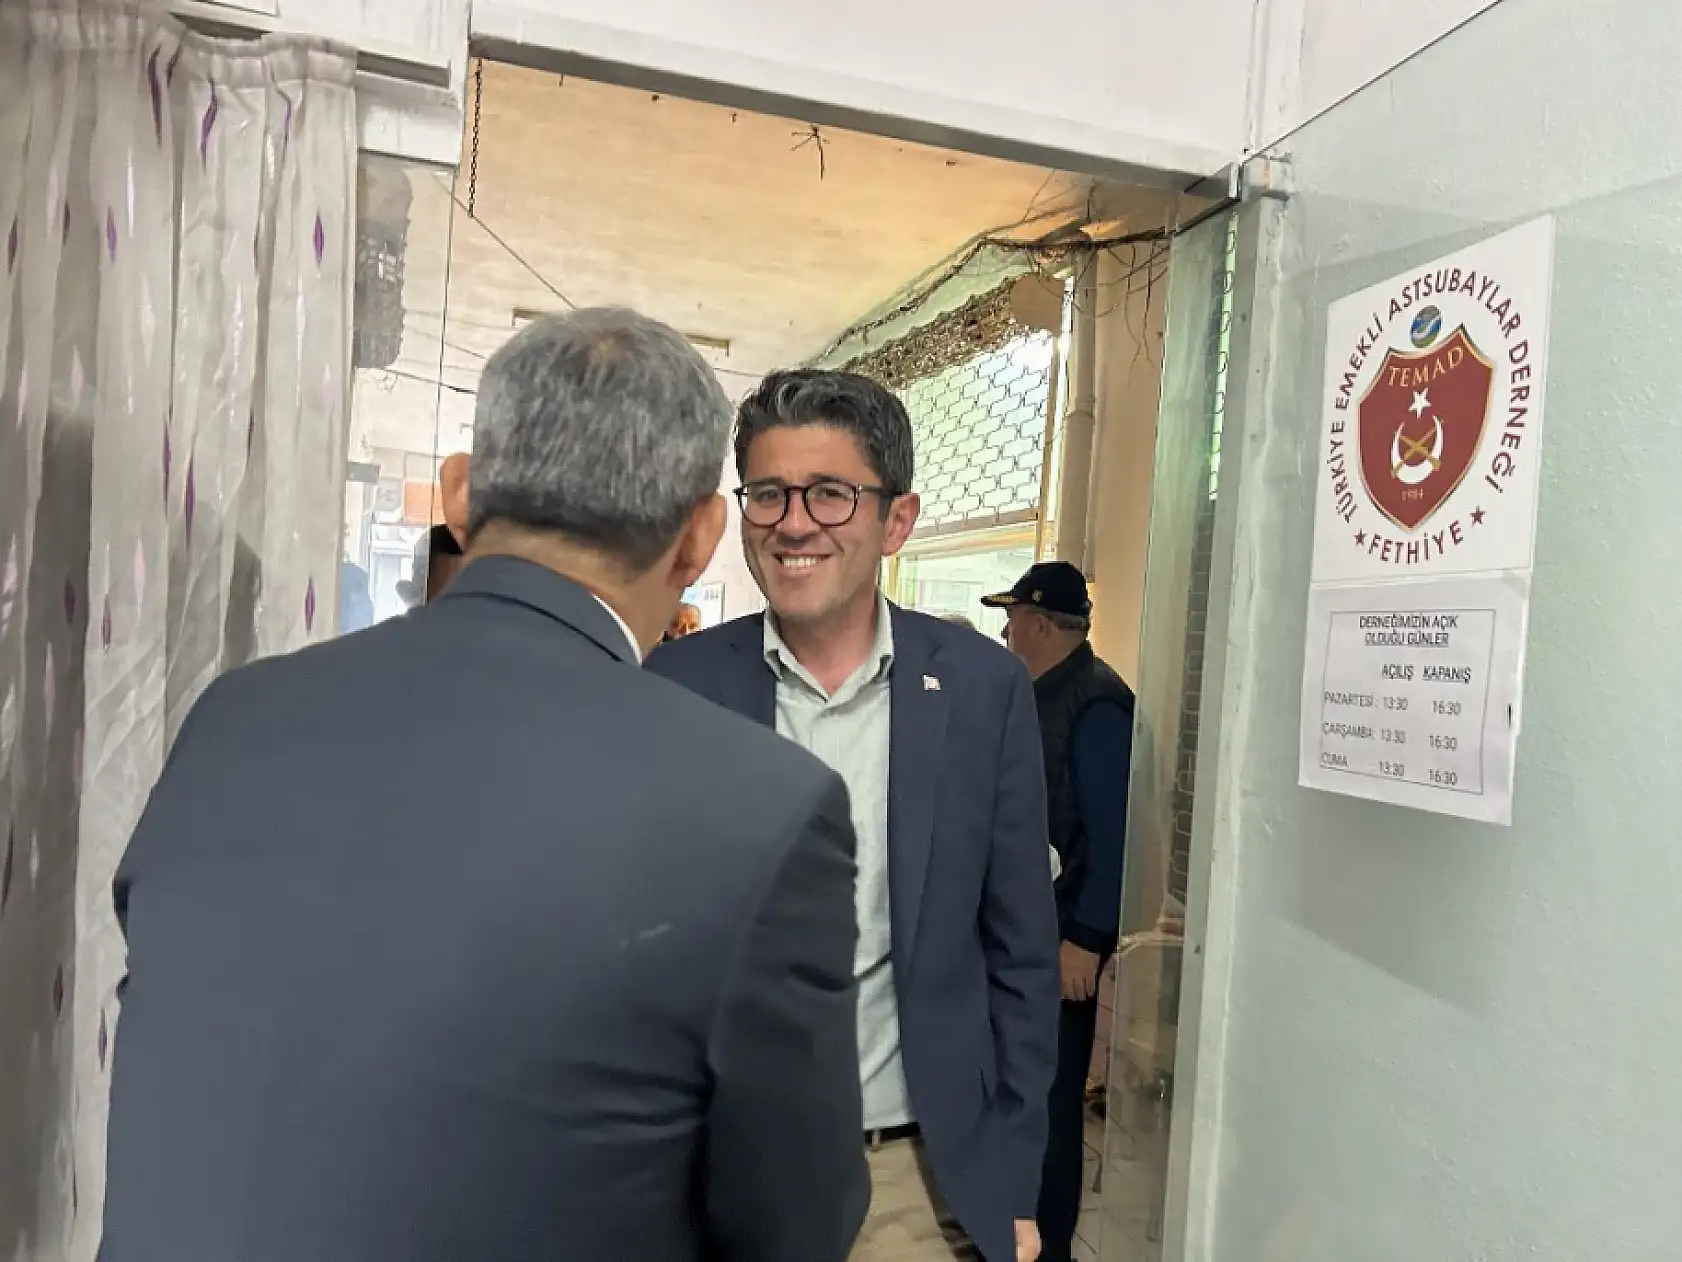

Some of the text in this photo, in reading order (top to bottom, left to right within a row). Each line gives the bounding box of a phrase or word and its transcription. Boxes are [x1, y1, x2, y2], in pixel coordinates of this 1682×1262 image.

[1387, 345, 1465, 388] TEMAD
[1326, 268, 1531, 523] TÜRKİYE EMEKLİ ASTSUBAYLAR DERNEĞİ
[1368, 520, 1465, 565] FETHİYE
[1359, 613, 1458, 630] DERNEĞİMİZİN AÇIK
[1364, 630, 1450, 646] OLDUĞU GÜNLER
[1381, 664, 1472, 684] AÇILIŞ KAPANIŞ
[1432, 700, 1462, 716] 16:30
[1429, 735, 1457, 751] 16:30
[1428, 769, 1458, 786] 16:30
